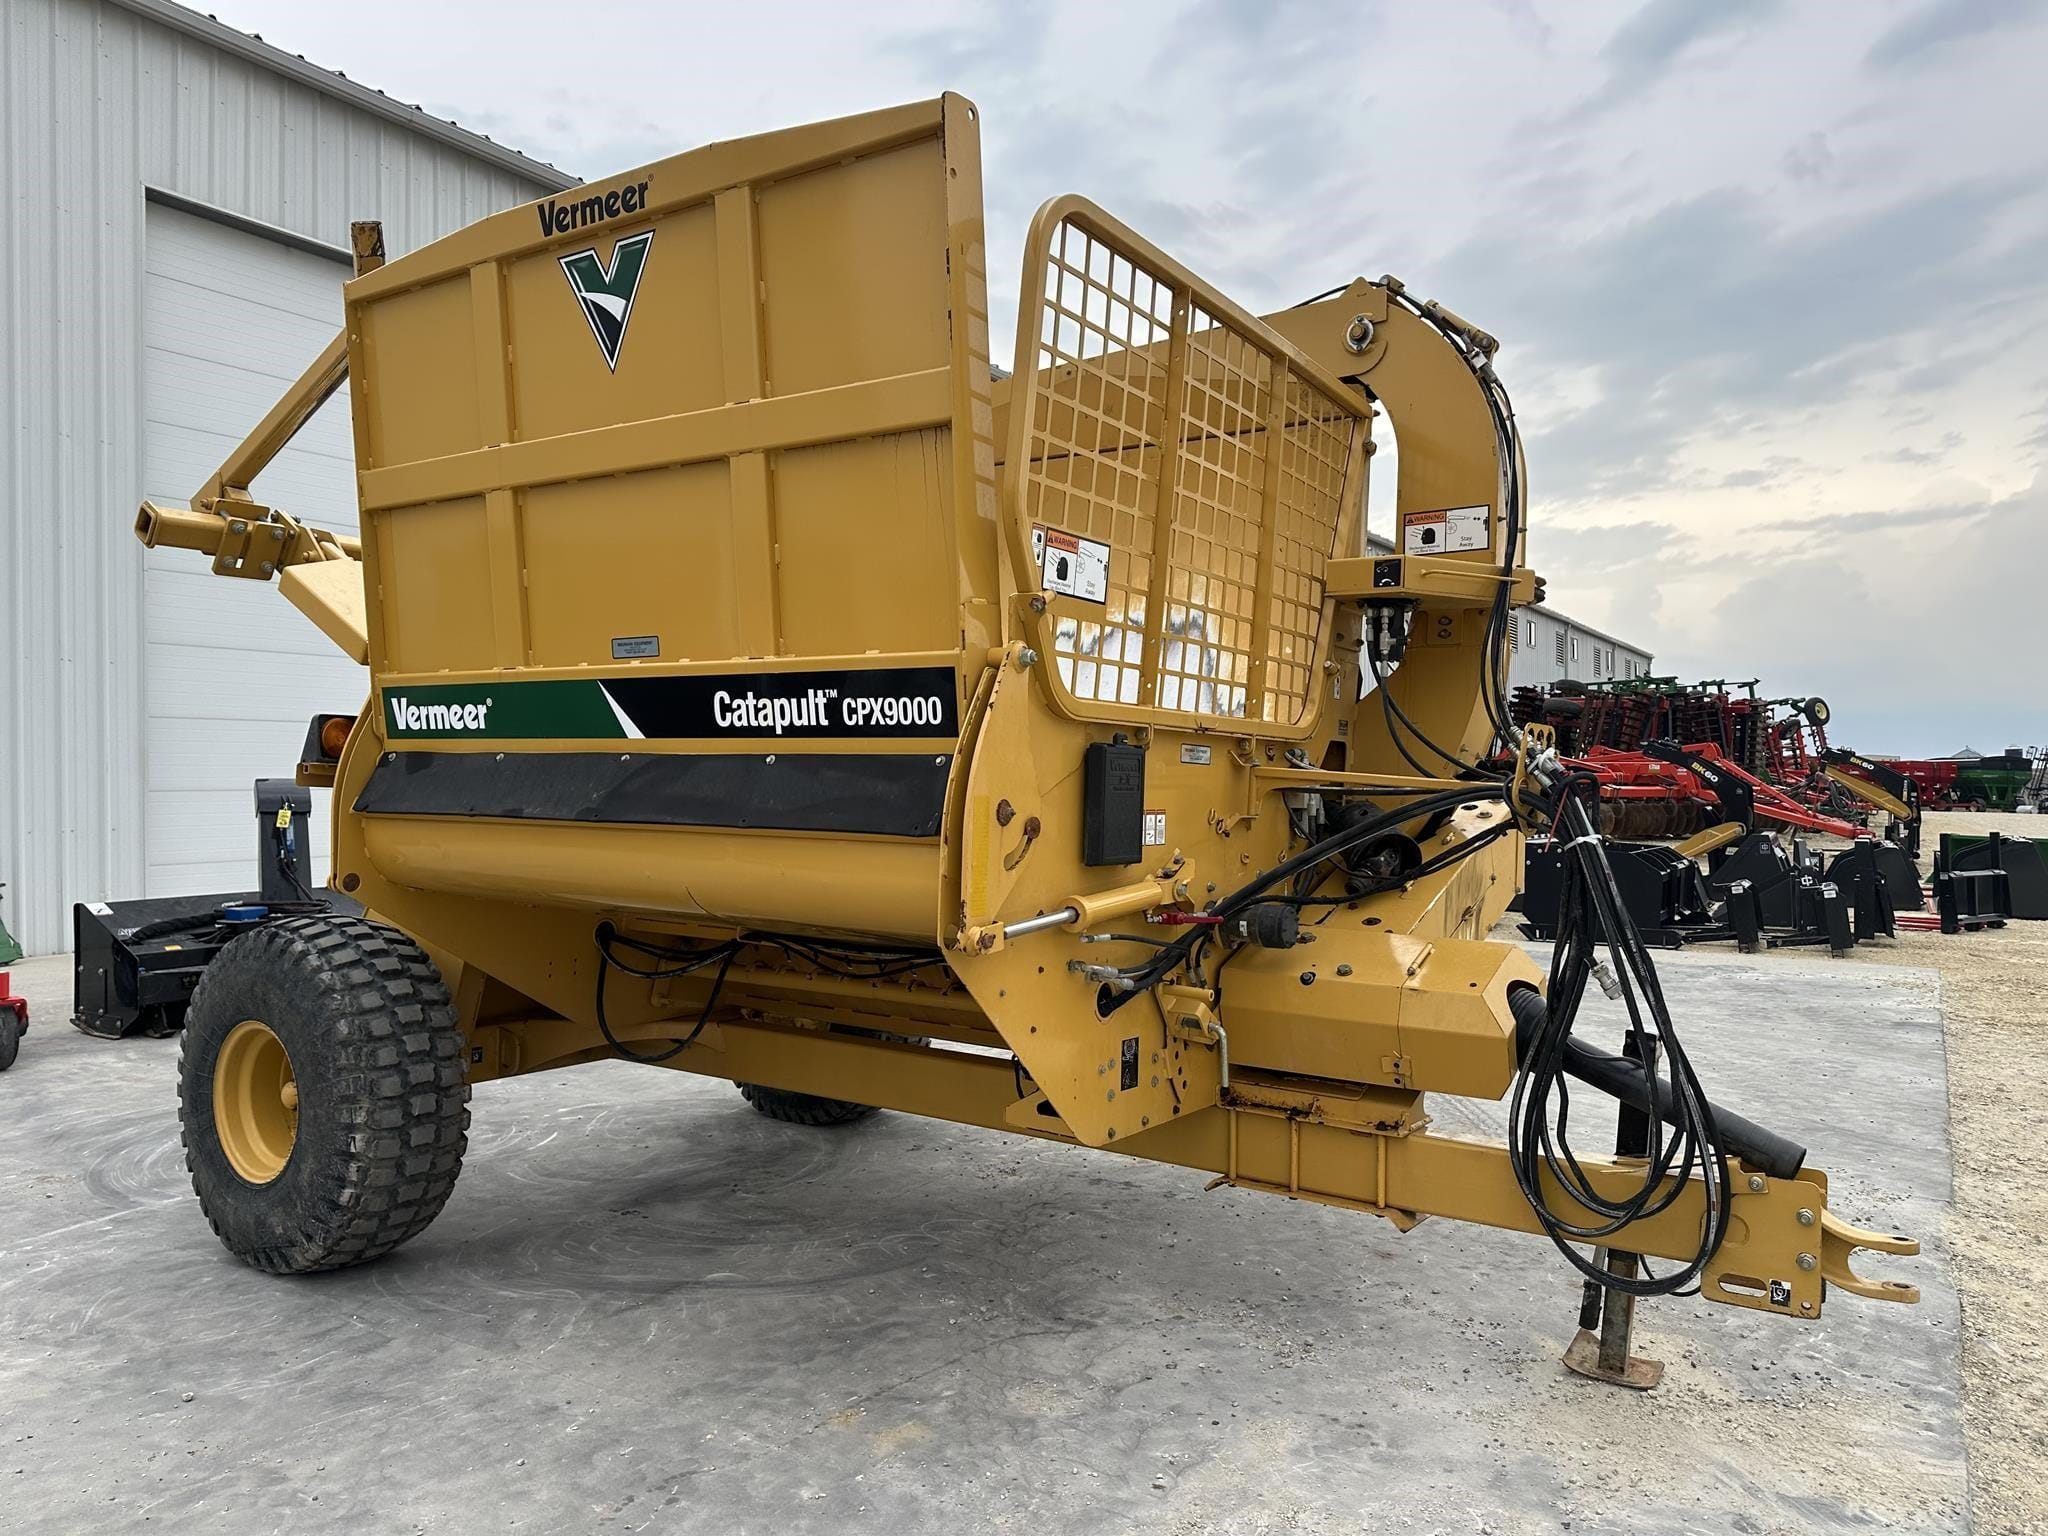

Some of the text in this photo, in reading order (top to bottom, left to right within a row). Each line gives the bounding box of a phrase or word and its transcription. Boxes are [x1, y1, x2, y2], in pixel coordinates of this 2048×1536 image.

[1412, 512, 1445, 523] WARNING
[1054, 535, 1077, 550] WARNING
[842, 696, 943, 726] CPX9000
